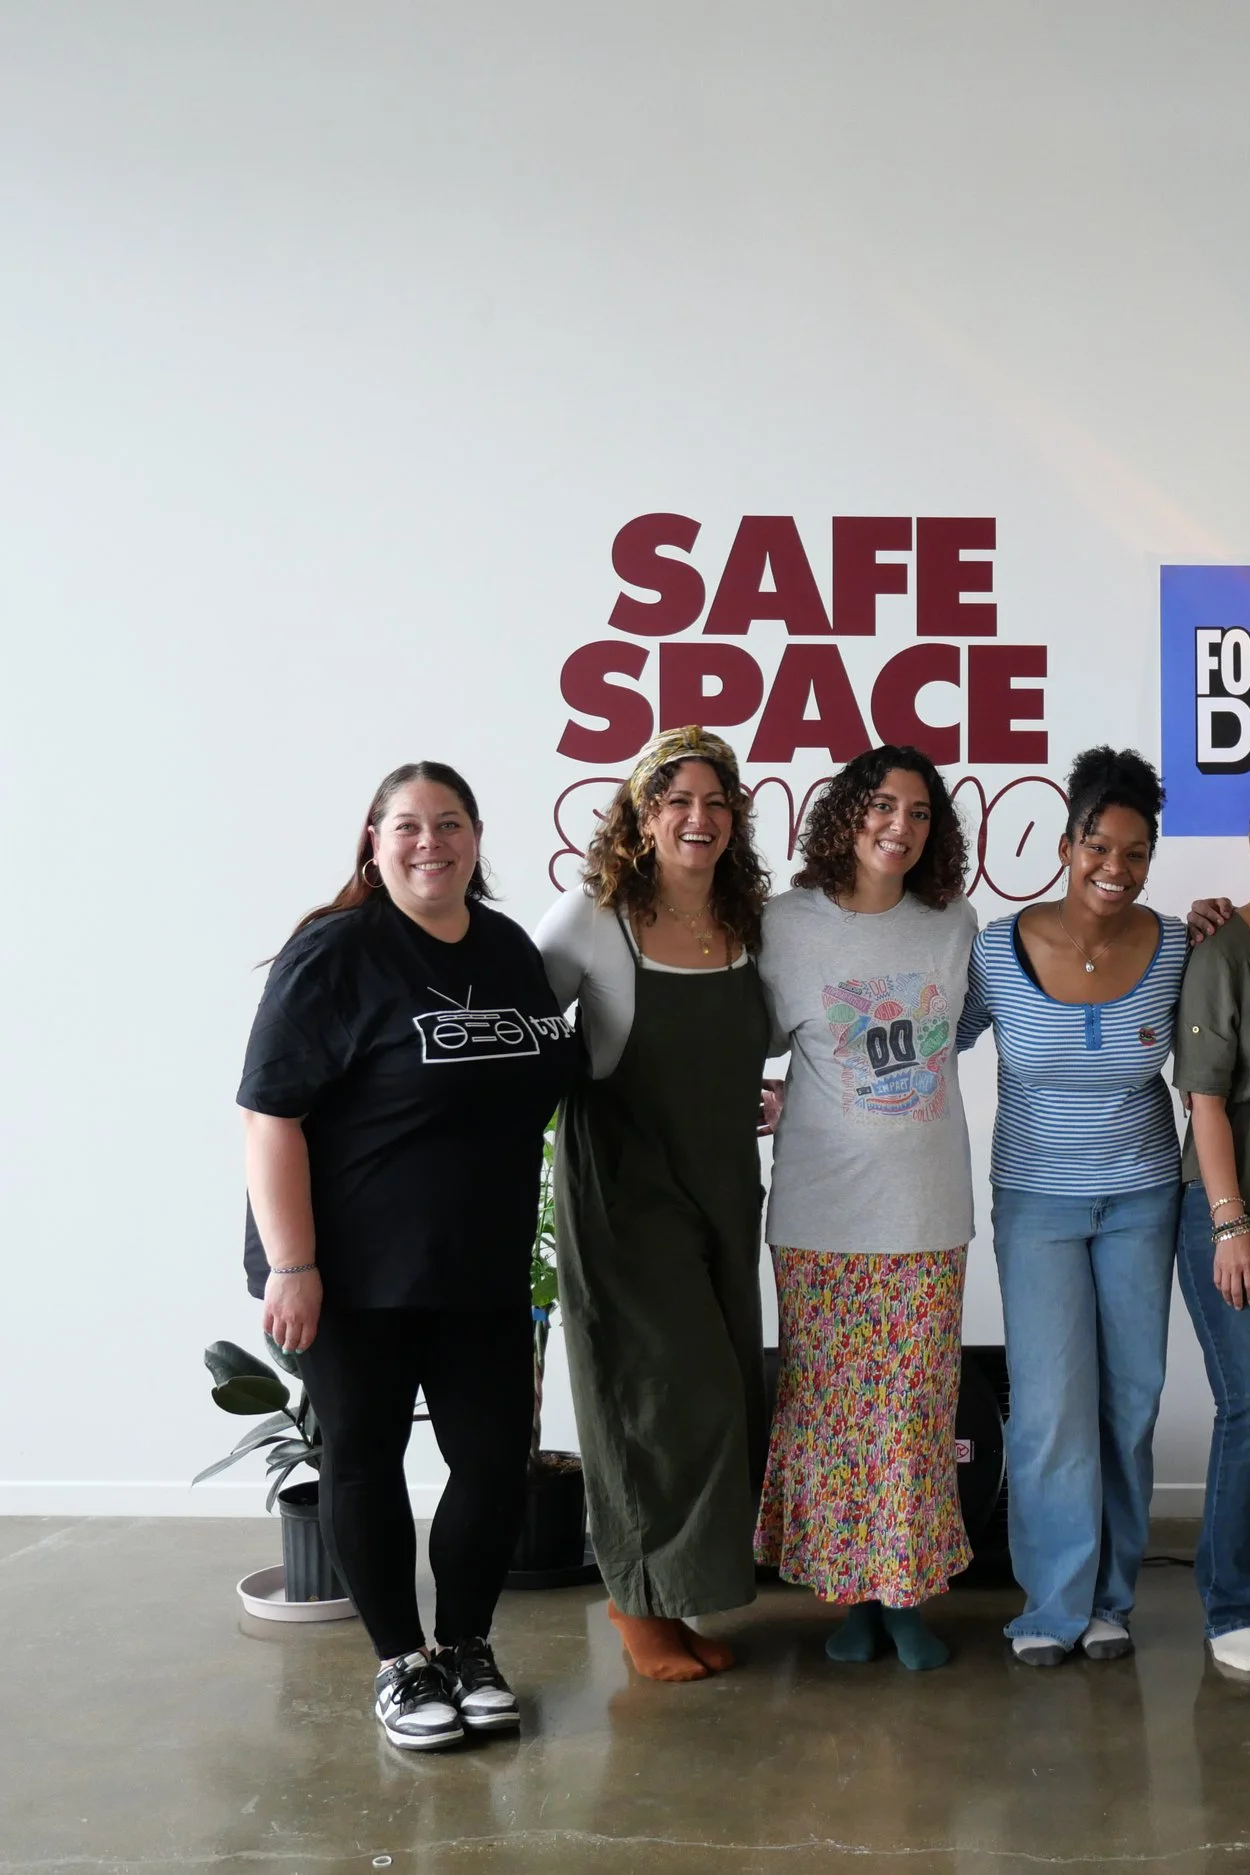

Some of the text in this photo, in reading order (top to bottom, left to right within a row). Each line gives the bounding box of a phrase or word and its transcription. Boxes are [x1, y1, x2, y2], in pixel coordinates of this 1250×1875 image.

[607, 512, 997, 636] SAFE
[556, 640, 1048, 765] SPACE
[529, 1016, 576, 1040] typ
[877, 1078, 909, 1093] IMPACT
